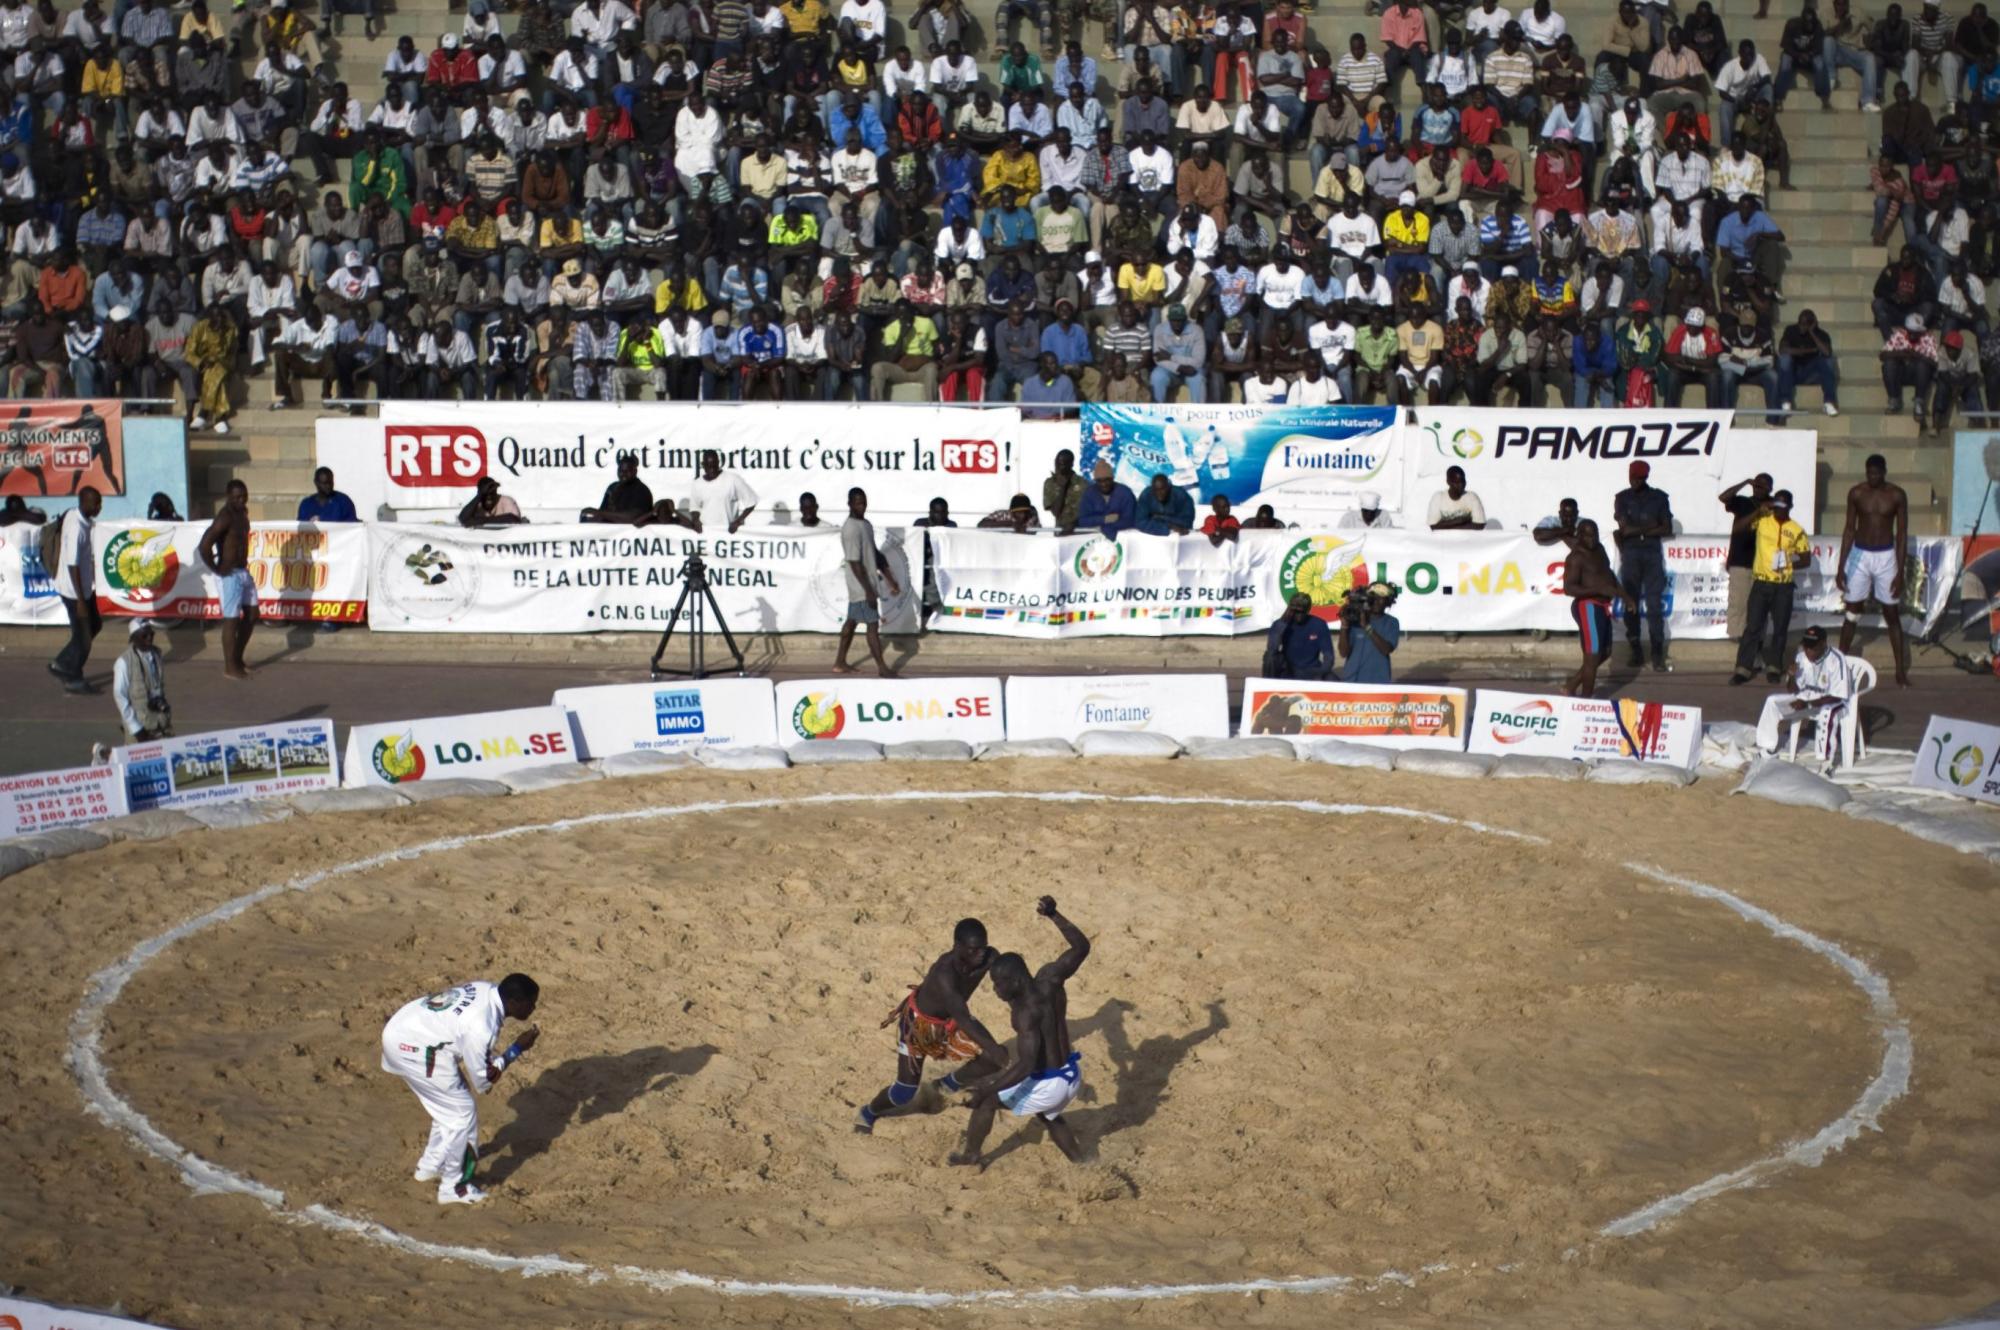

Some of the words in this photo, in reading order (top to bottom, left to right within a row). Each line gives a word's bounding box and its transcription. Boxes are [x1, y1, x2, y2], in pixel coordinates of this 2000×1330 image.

[1341, 419, 1383, 428] Naturelle
[21, 430, 101, 443] MOMENTS
[1495, 421, 1720, 460] PAMODZI
[55, 450, 89, 465] RTS
[390, 434, 482, 477] RTS
[498, 435, 585, 476] Quand
[800, 439, 856, 470] c'est
[865, 450, 905, 470] sur
[914, 438, 935, 470] la
[943, 444, 996, 468] RTS
[1284, 446, 1376, 470] Fontaine
[570, 538, 675, 557] NATIONAL
[682, 539, 709, 556] DE
[715, 540, 806, 559] GESTION
[1668, 547, 1728, 559] RESIDEN
[514, 569, 539, 587] DE
[547, 569, 571, 588] LA
[577, 568, 638, 586] LUTTE
[646, 567, 674, 586] AU
[708, 568, 777, 587] NEGAL
[956, 587, 973, 600] LA
[980, 590, 1040, 607] CEDEAO
[1046, 592, 1087, 607] POUR
[1164, 587, 1191, 600] DES
[1198, 585, 1256, 601] PEUPLES
[177, 602, 220, 615] Gains
[311, 602, 340, 617] 200
[346, 603, 358, 617] F
[652, 605, 691, 620] Lue
[655, 694, 701, 709] SATTAR
[857, 697, 992, 723] LO.NA.SE
[1331, 704, 1348, 712] LES
[1352, 704, 1393, 712] GRANDS
[1085, 704, 1151, 723] Fontaine
[1416, 716, 1440, 726] RTS
[1489, 712, 1559, 730] PACIFIC
[660, 715, 701, 730] IMMO
[1583, 726, 1598, 734] 33
[434, 732, 566, 765] LO.NA.SE
[1581, 737, 1596, 745] 33
[47, 775, 61, 785] DE
[64, 768, 112, 783] VOITURES
[133, 780, 168, 796] IMMO
[17, 802, 33, 813] 33
[38, 799, 61, 810] 821
[88, 792, 104, 803] 55
[20, 815, 36, 825] 33
[41, 811, 65, 822] 889
[71, 807, 87, 817] 40
[91, 804, 108, 815] 40
